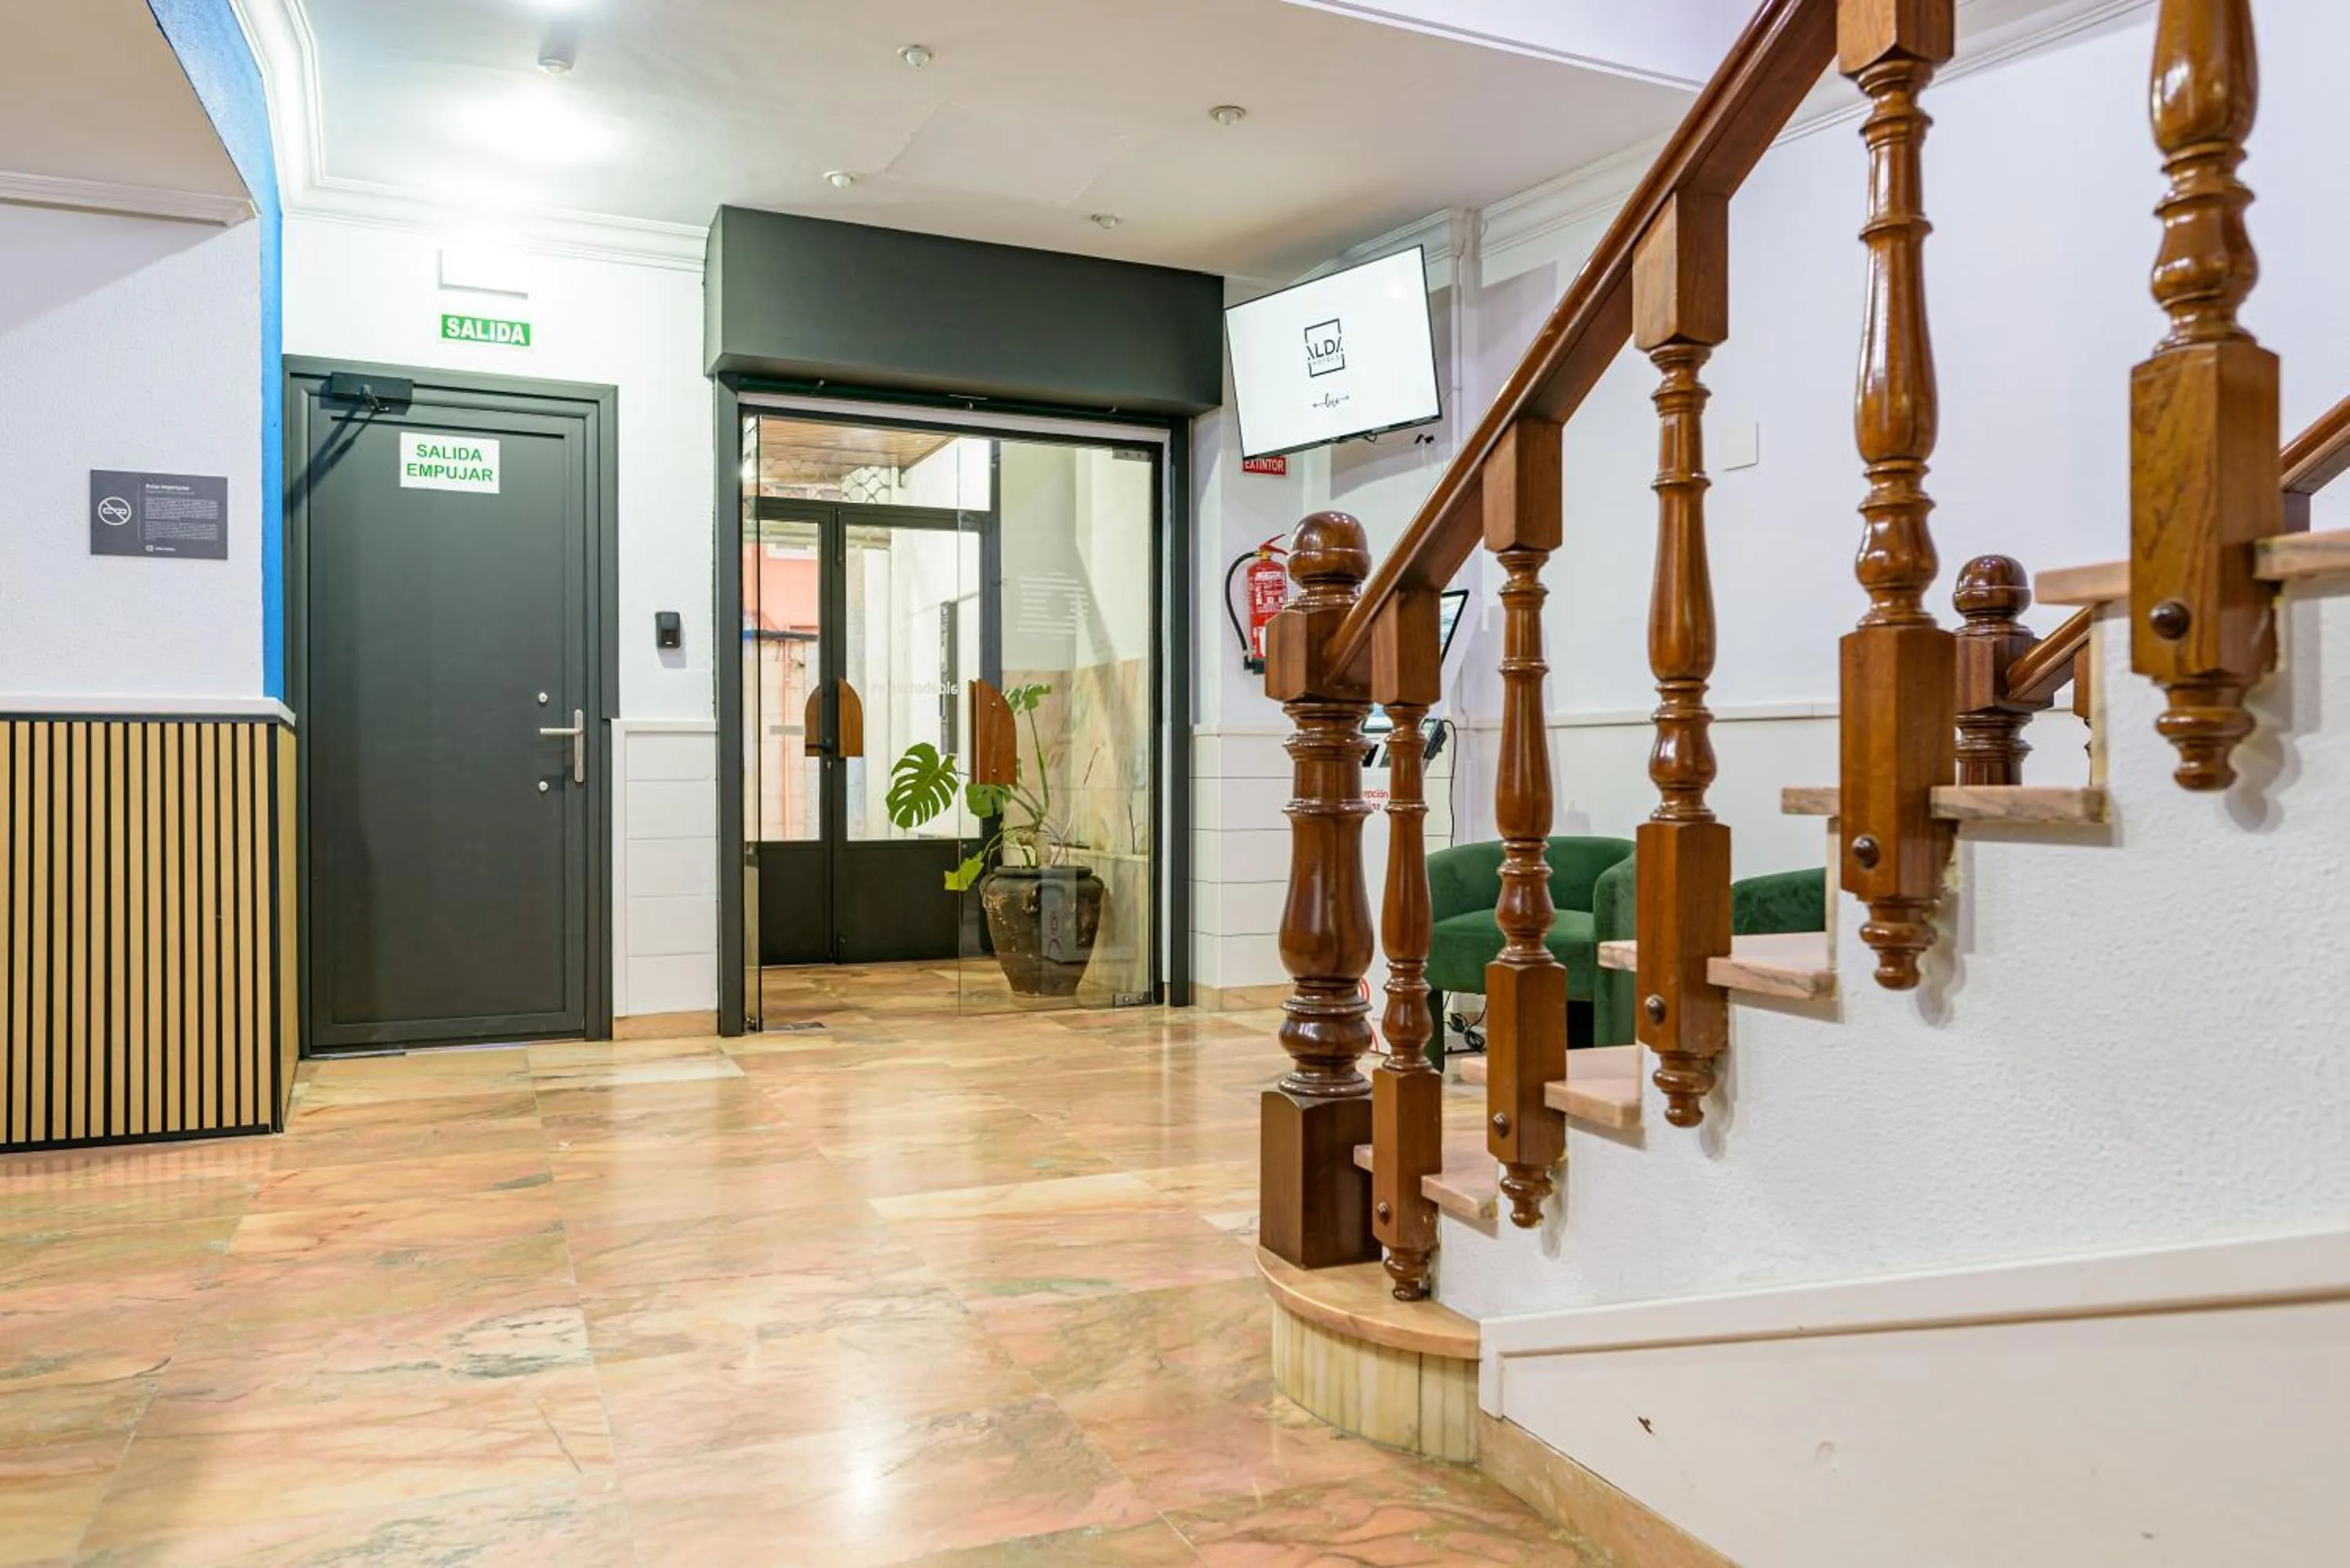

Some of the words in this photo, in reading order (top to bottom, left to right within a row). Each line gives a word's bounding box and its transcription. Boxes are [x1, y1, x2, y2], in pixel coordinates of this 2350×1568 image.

[446, 317, 526, 344] SALIDA
[416, 444, 483, 462] SALIDA
[407, 463, 494, 482] EMPUJAR
[1246, 458, 1284, 471] EXTINTOR
